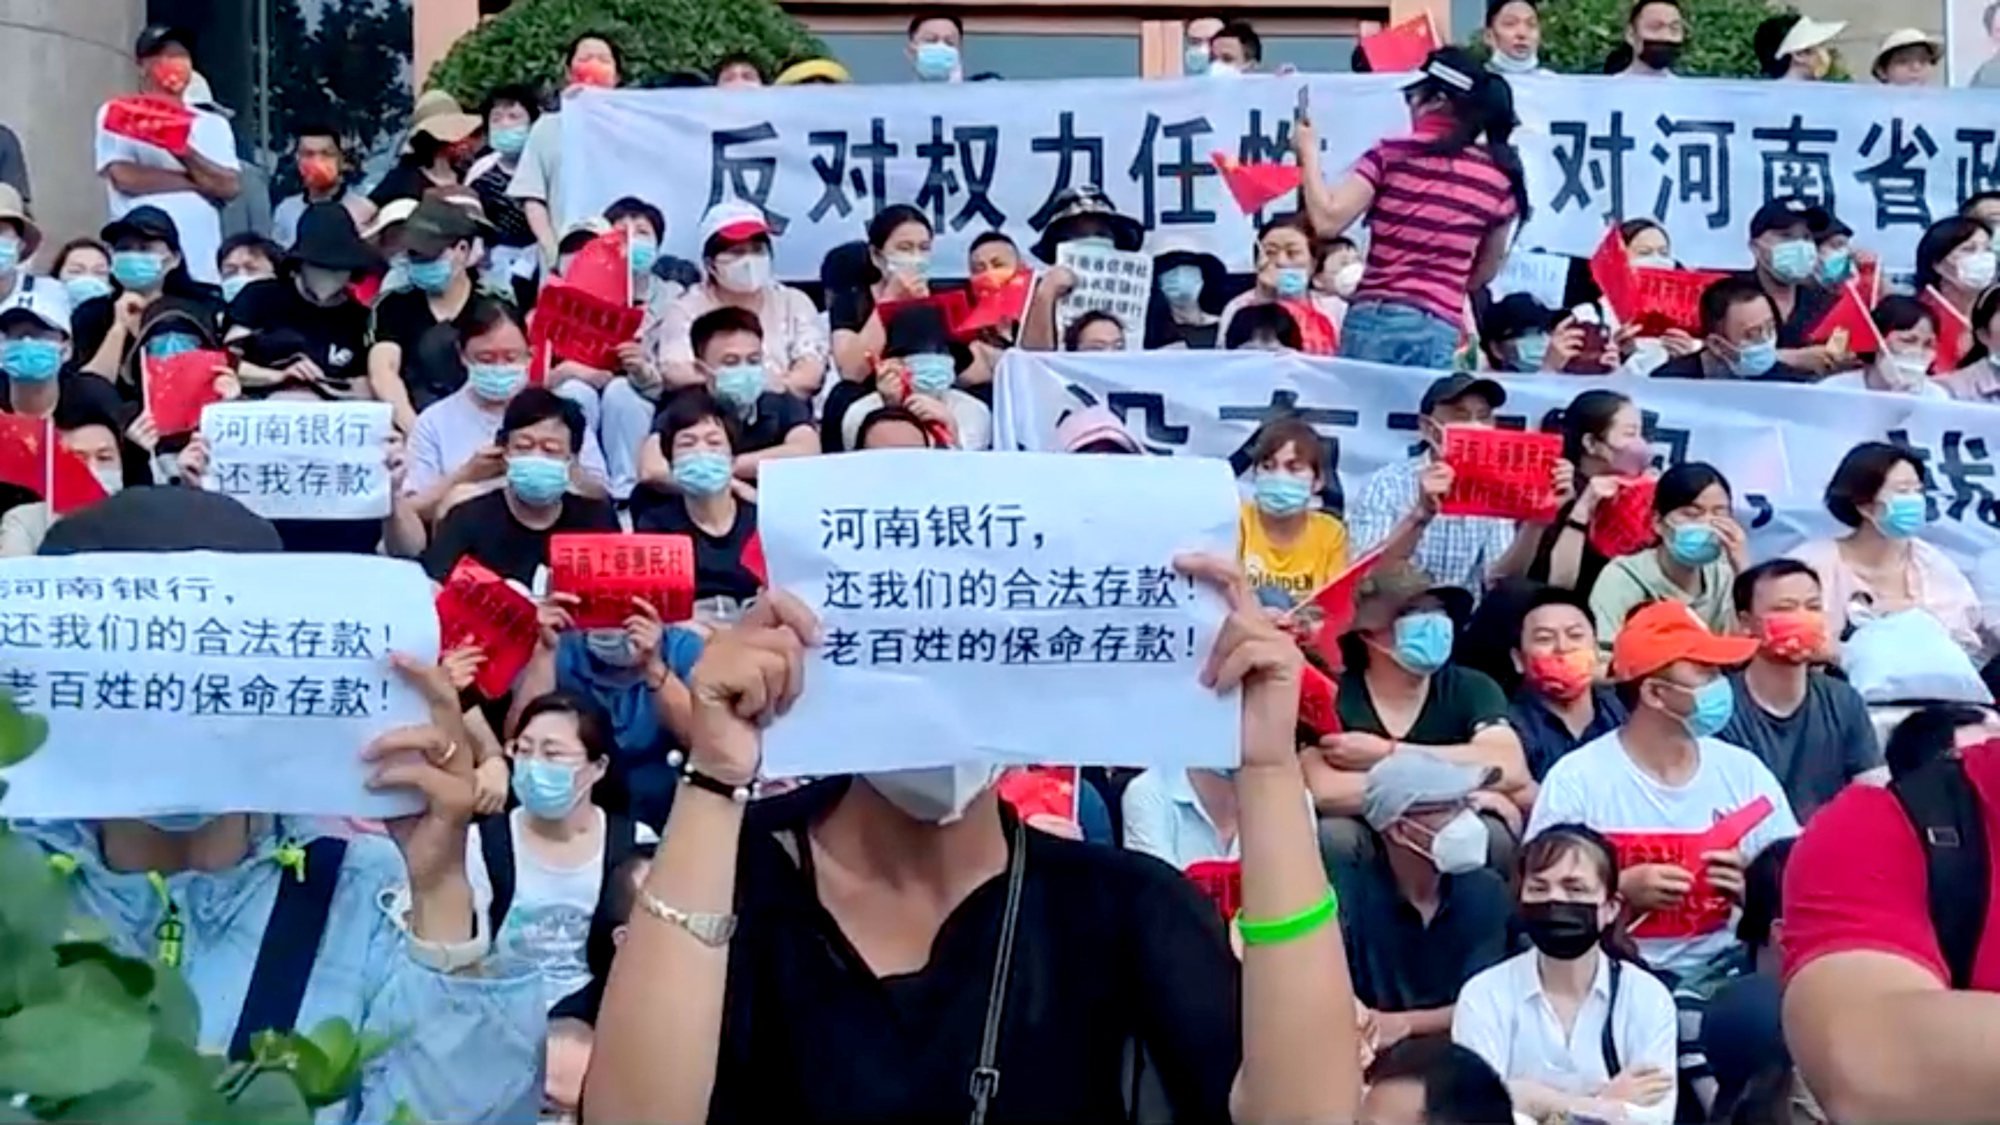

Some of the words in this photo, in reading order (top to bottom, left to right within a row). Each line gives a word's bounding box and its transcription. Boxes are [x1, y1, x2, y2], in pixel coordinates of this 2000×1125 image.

[215, 413, 371, 446] 河南银行
[215, 462, 372, 496] 还我存款
[821, 504, 1046, 550] 河南银行，
[0, 577, 234, 604] 河南银行，
[822, 565, 1196, 609] 还我们的合法存款！
[0, 611, 392, 658] 还我们的合法存款！
[822, 624, 1195, 666] 老百姓的保命存款！
[1, 668, 390, 716] 老百姓的保命存款！
